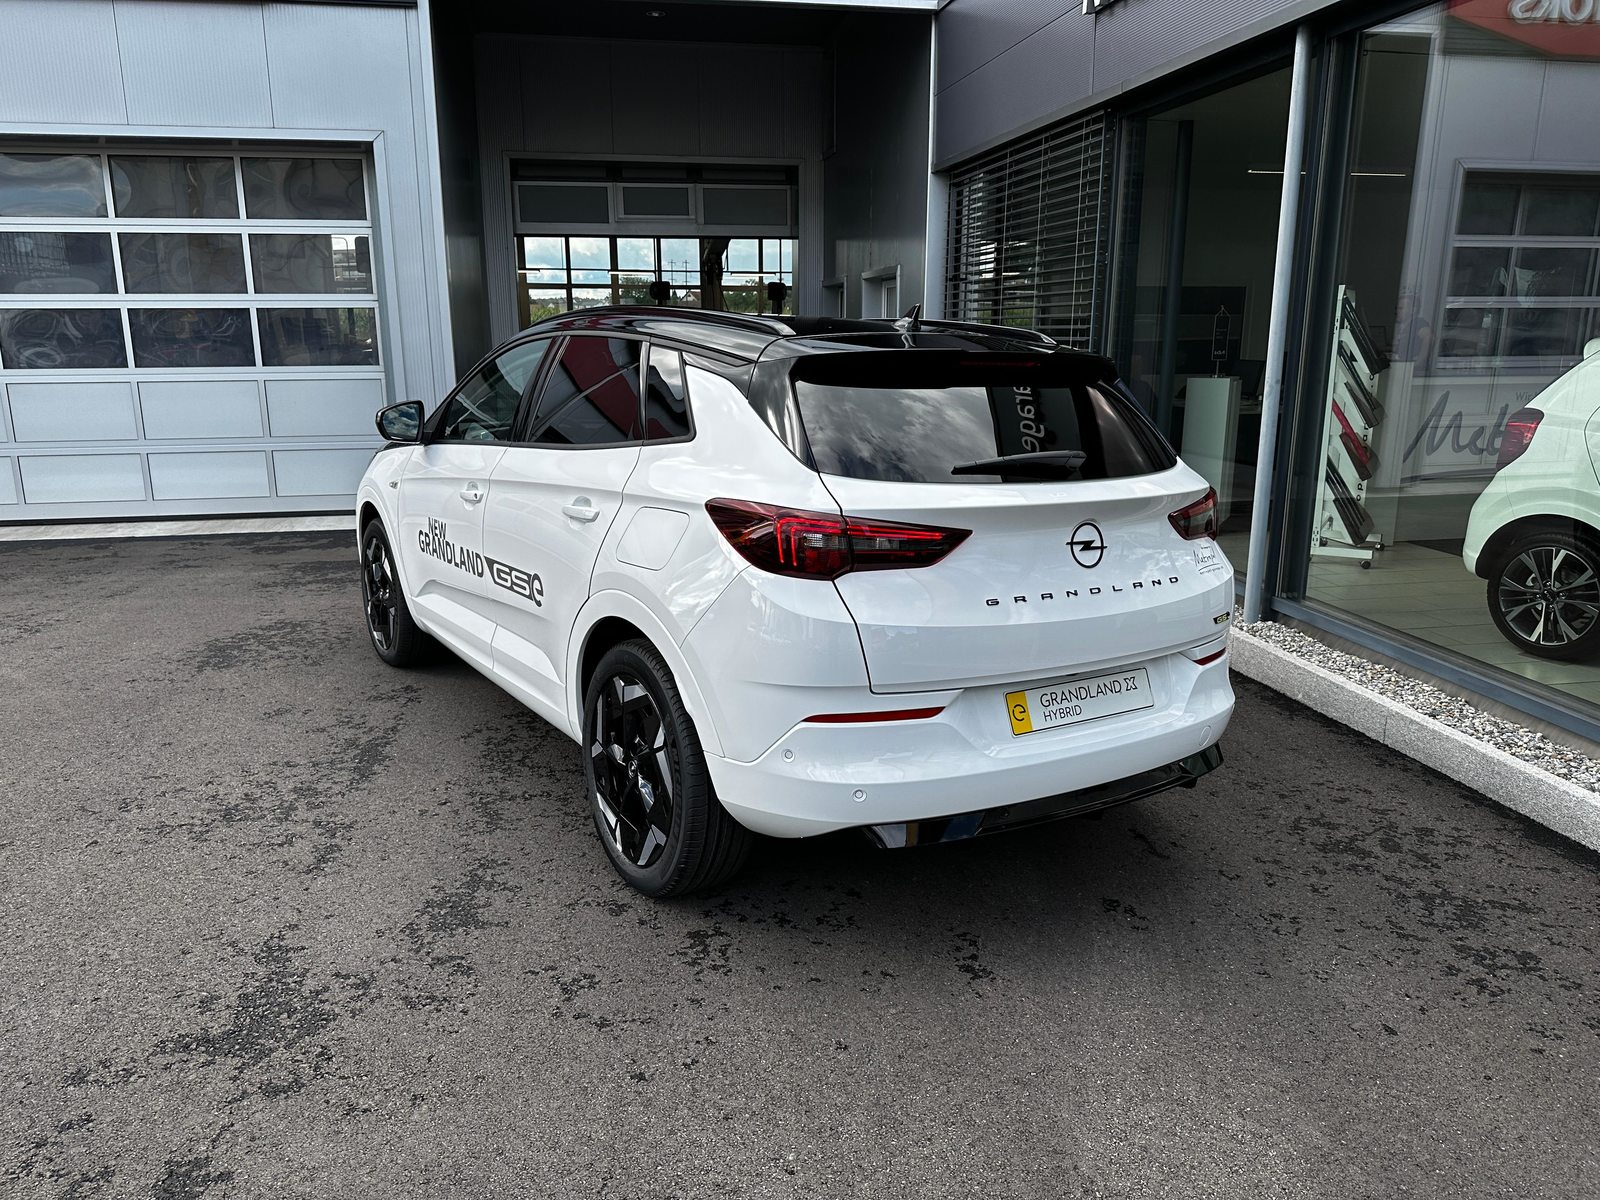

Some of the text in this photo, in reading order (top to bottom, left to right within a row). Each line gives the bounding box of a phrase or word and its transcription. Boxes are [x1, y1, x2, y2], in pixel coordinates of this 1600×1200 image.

[428, 516, 447, 540] NEW
[418, 530, 484, 578] GRANDLAND
[986, 576, 1179, 607] GRANDLAND
[1040, 676, 1138, 708] GRANDLAND X
[1043, 705, 1082, 722] HYBRID
